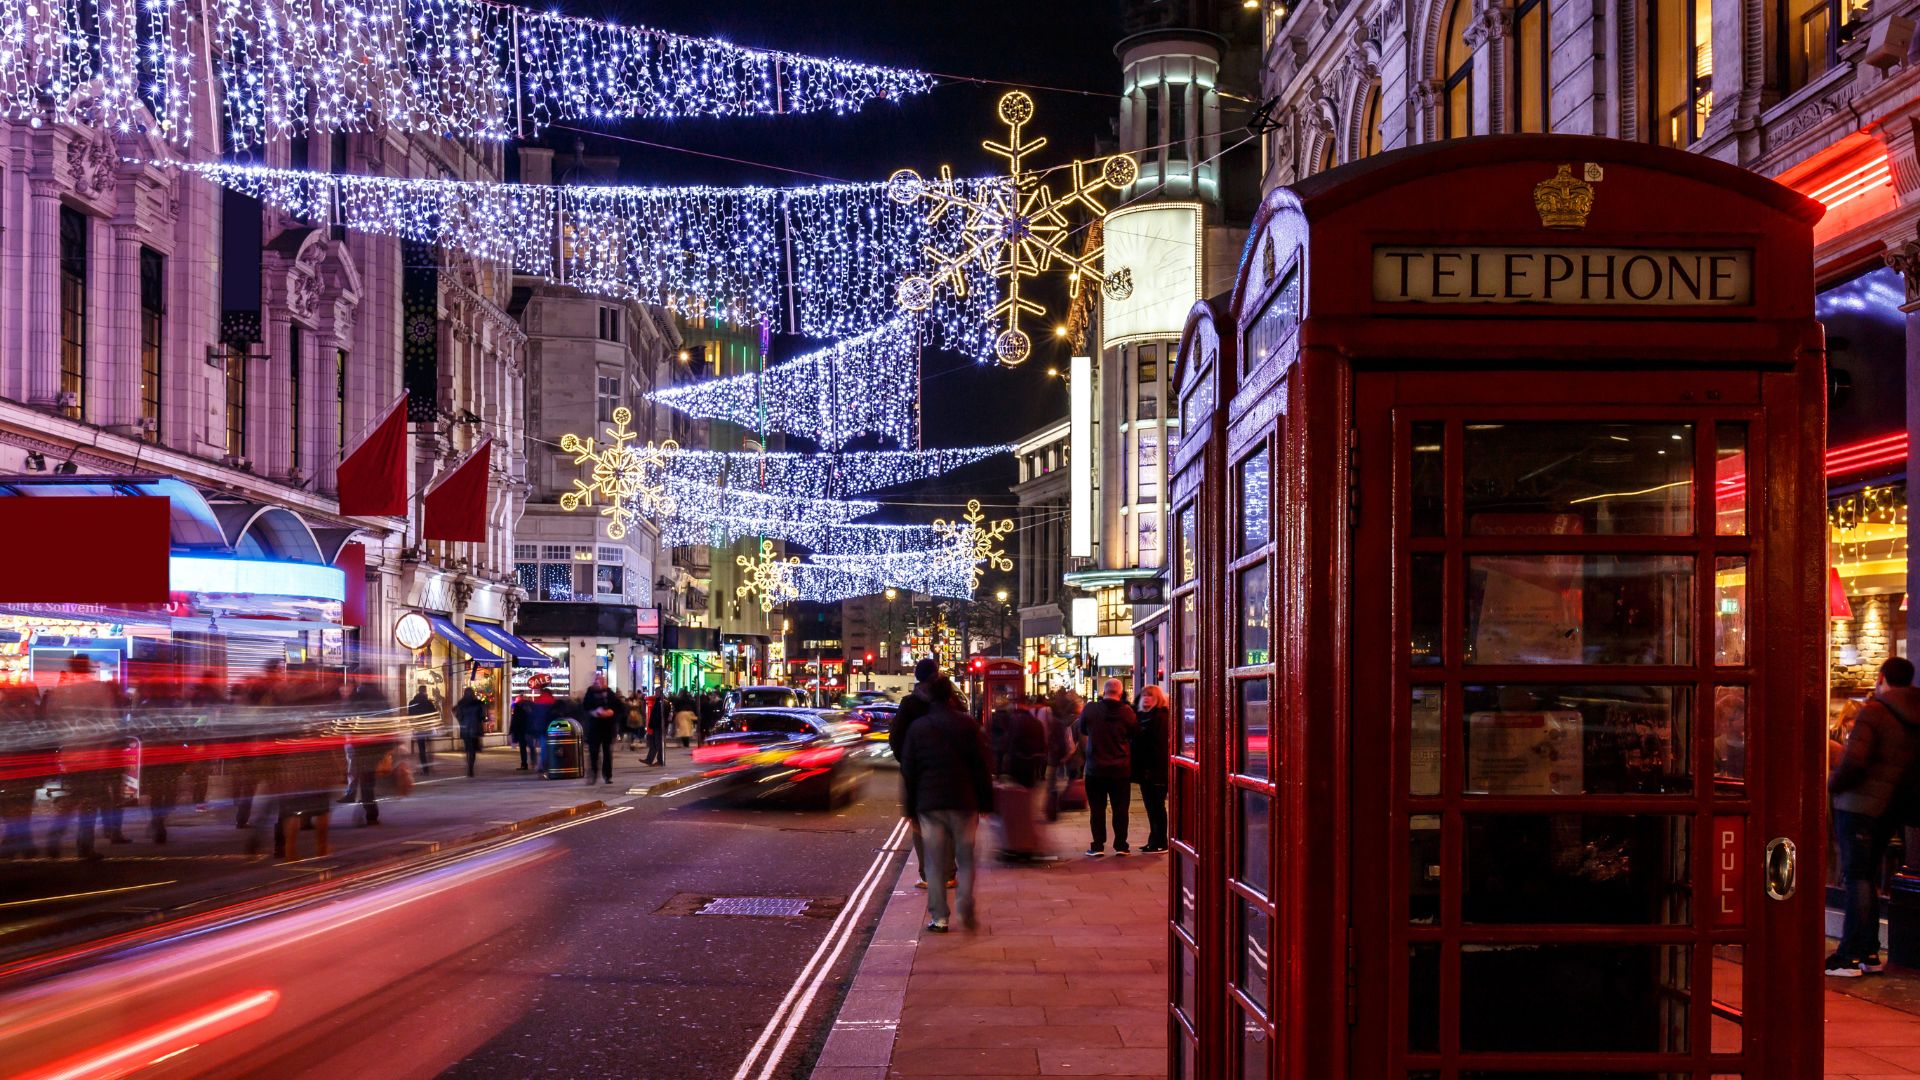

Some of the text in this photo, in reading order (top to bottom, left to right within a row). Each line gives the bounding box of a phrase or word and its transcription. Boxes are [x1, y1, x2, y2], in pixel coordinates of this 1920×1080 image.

[1385, 252, 1738, 301] TELEPHONE
[33, 602, 43, 612] &
[46, 602, 106, 614] Souvenir
[528, 675, 551, 689] SALE
[1721, 831, 1735, 913] PULL
